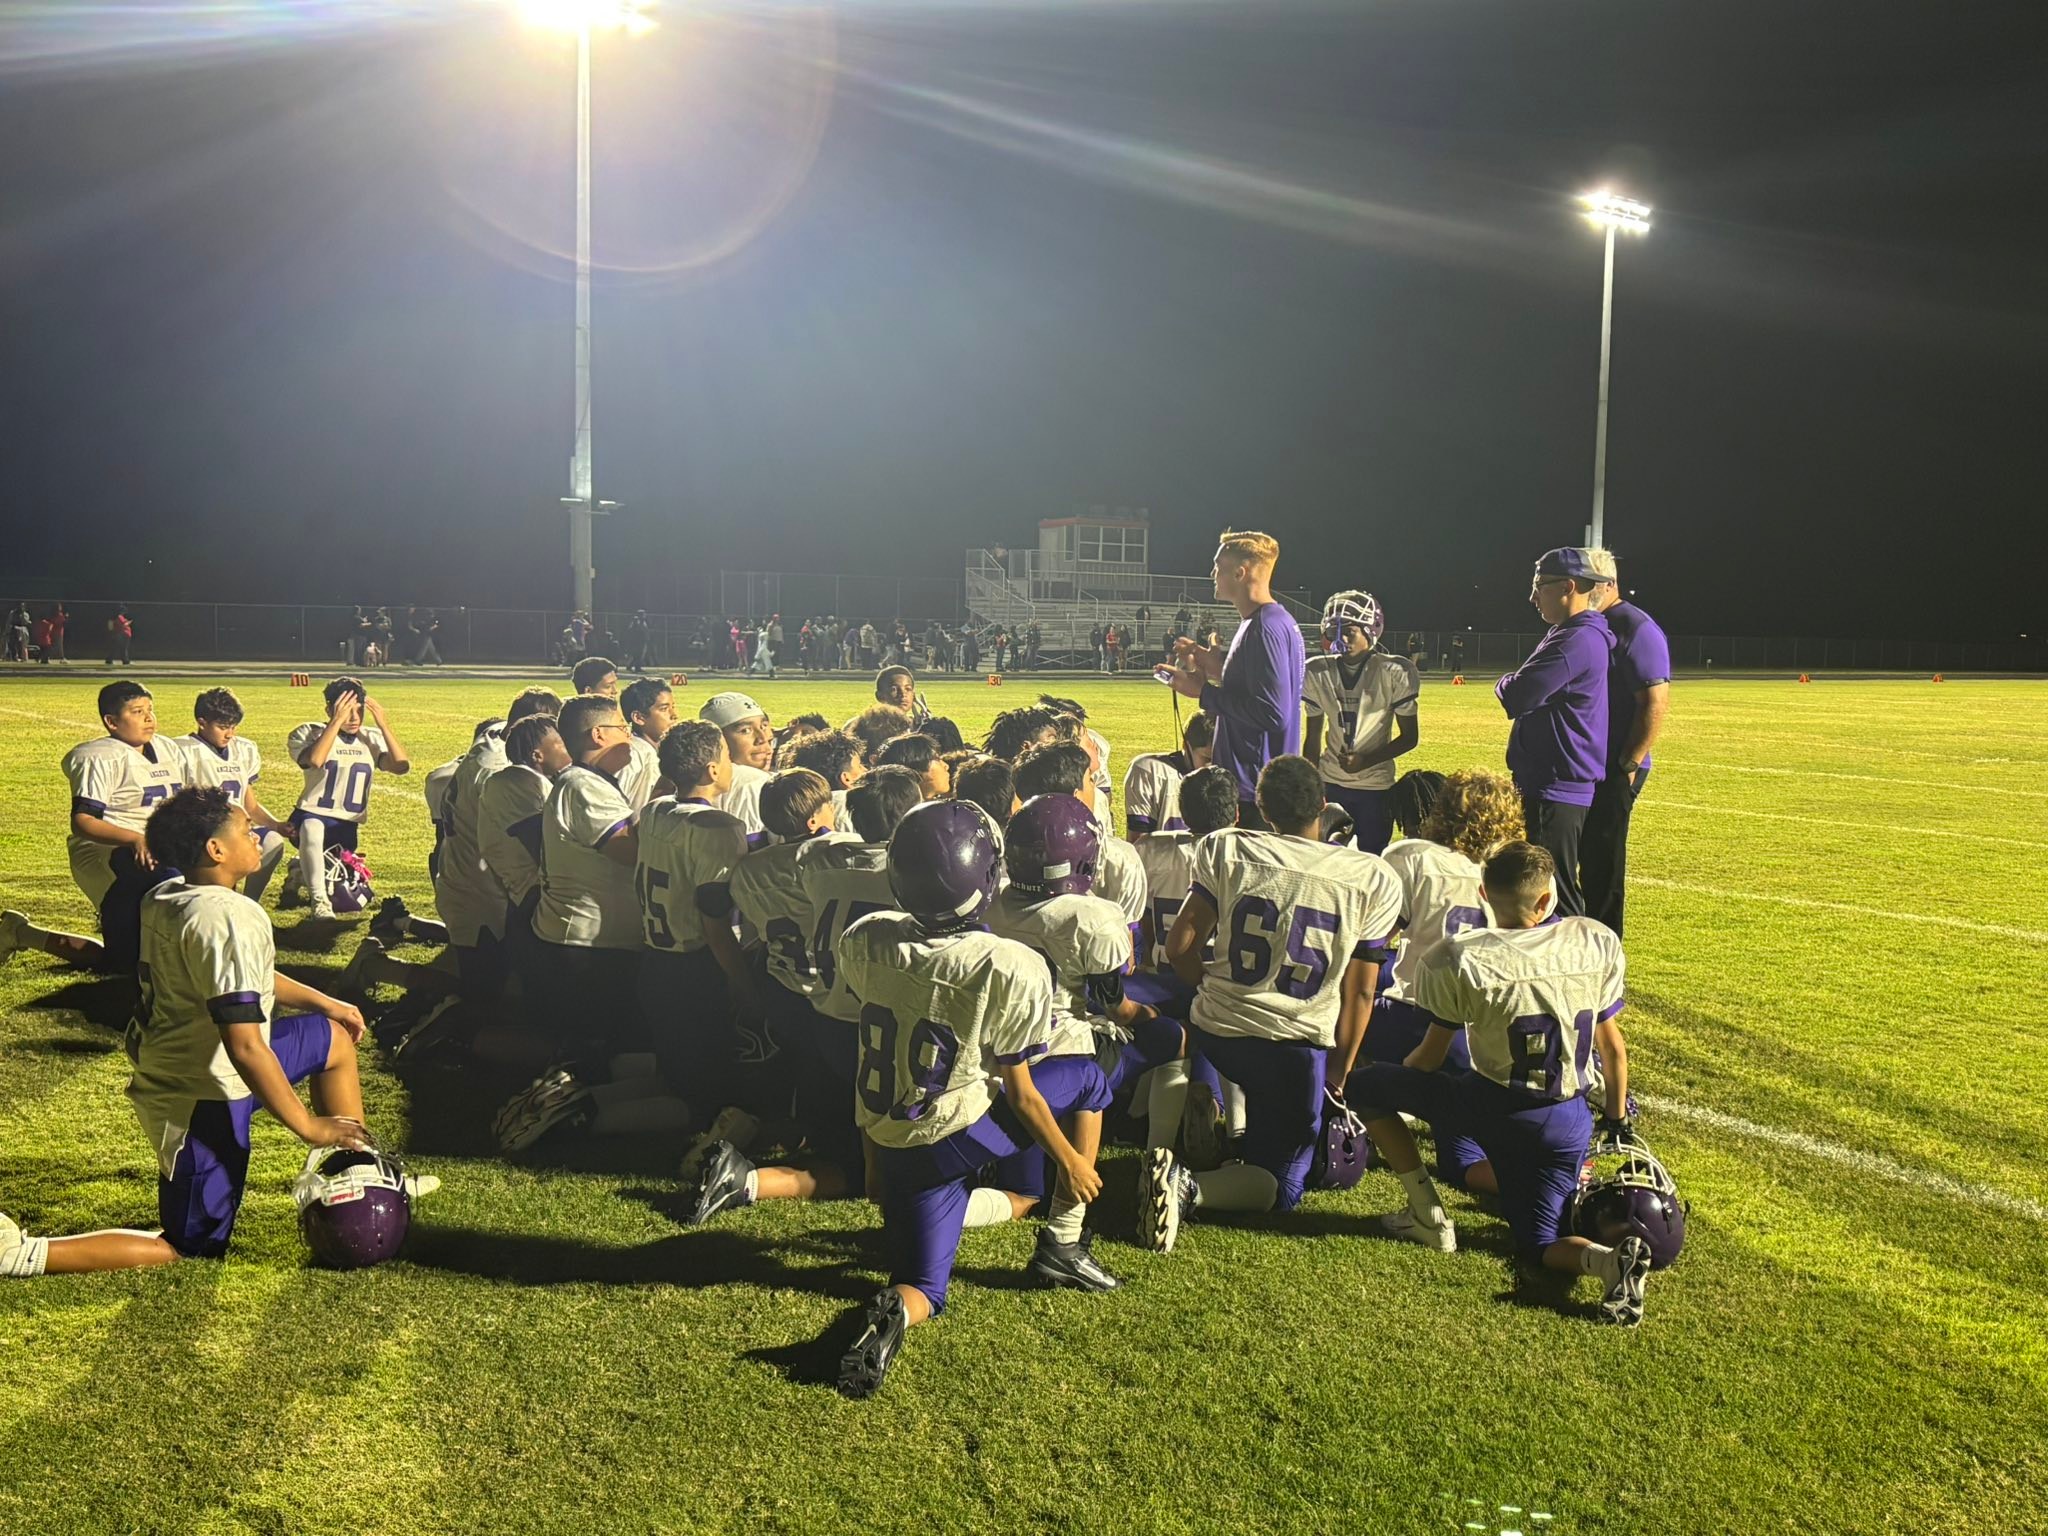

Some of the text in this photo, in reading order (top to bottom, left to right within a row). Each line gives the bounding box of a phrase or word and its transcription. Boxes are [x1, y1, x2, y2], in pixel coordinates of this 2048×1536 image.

[294, 674, 309, 687] 10
[674, 674, 688, 686] 20
[990, 675, 1002, 687] 30
[317, 759, 373, 814] 10
[1229, 894, 1341, 1001] 65
[1507, 1008, 1595, 1099] 81
